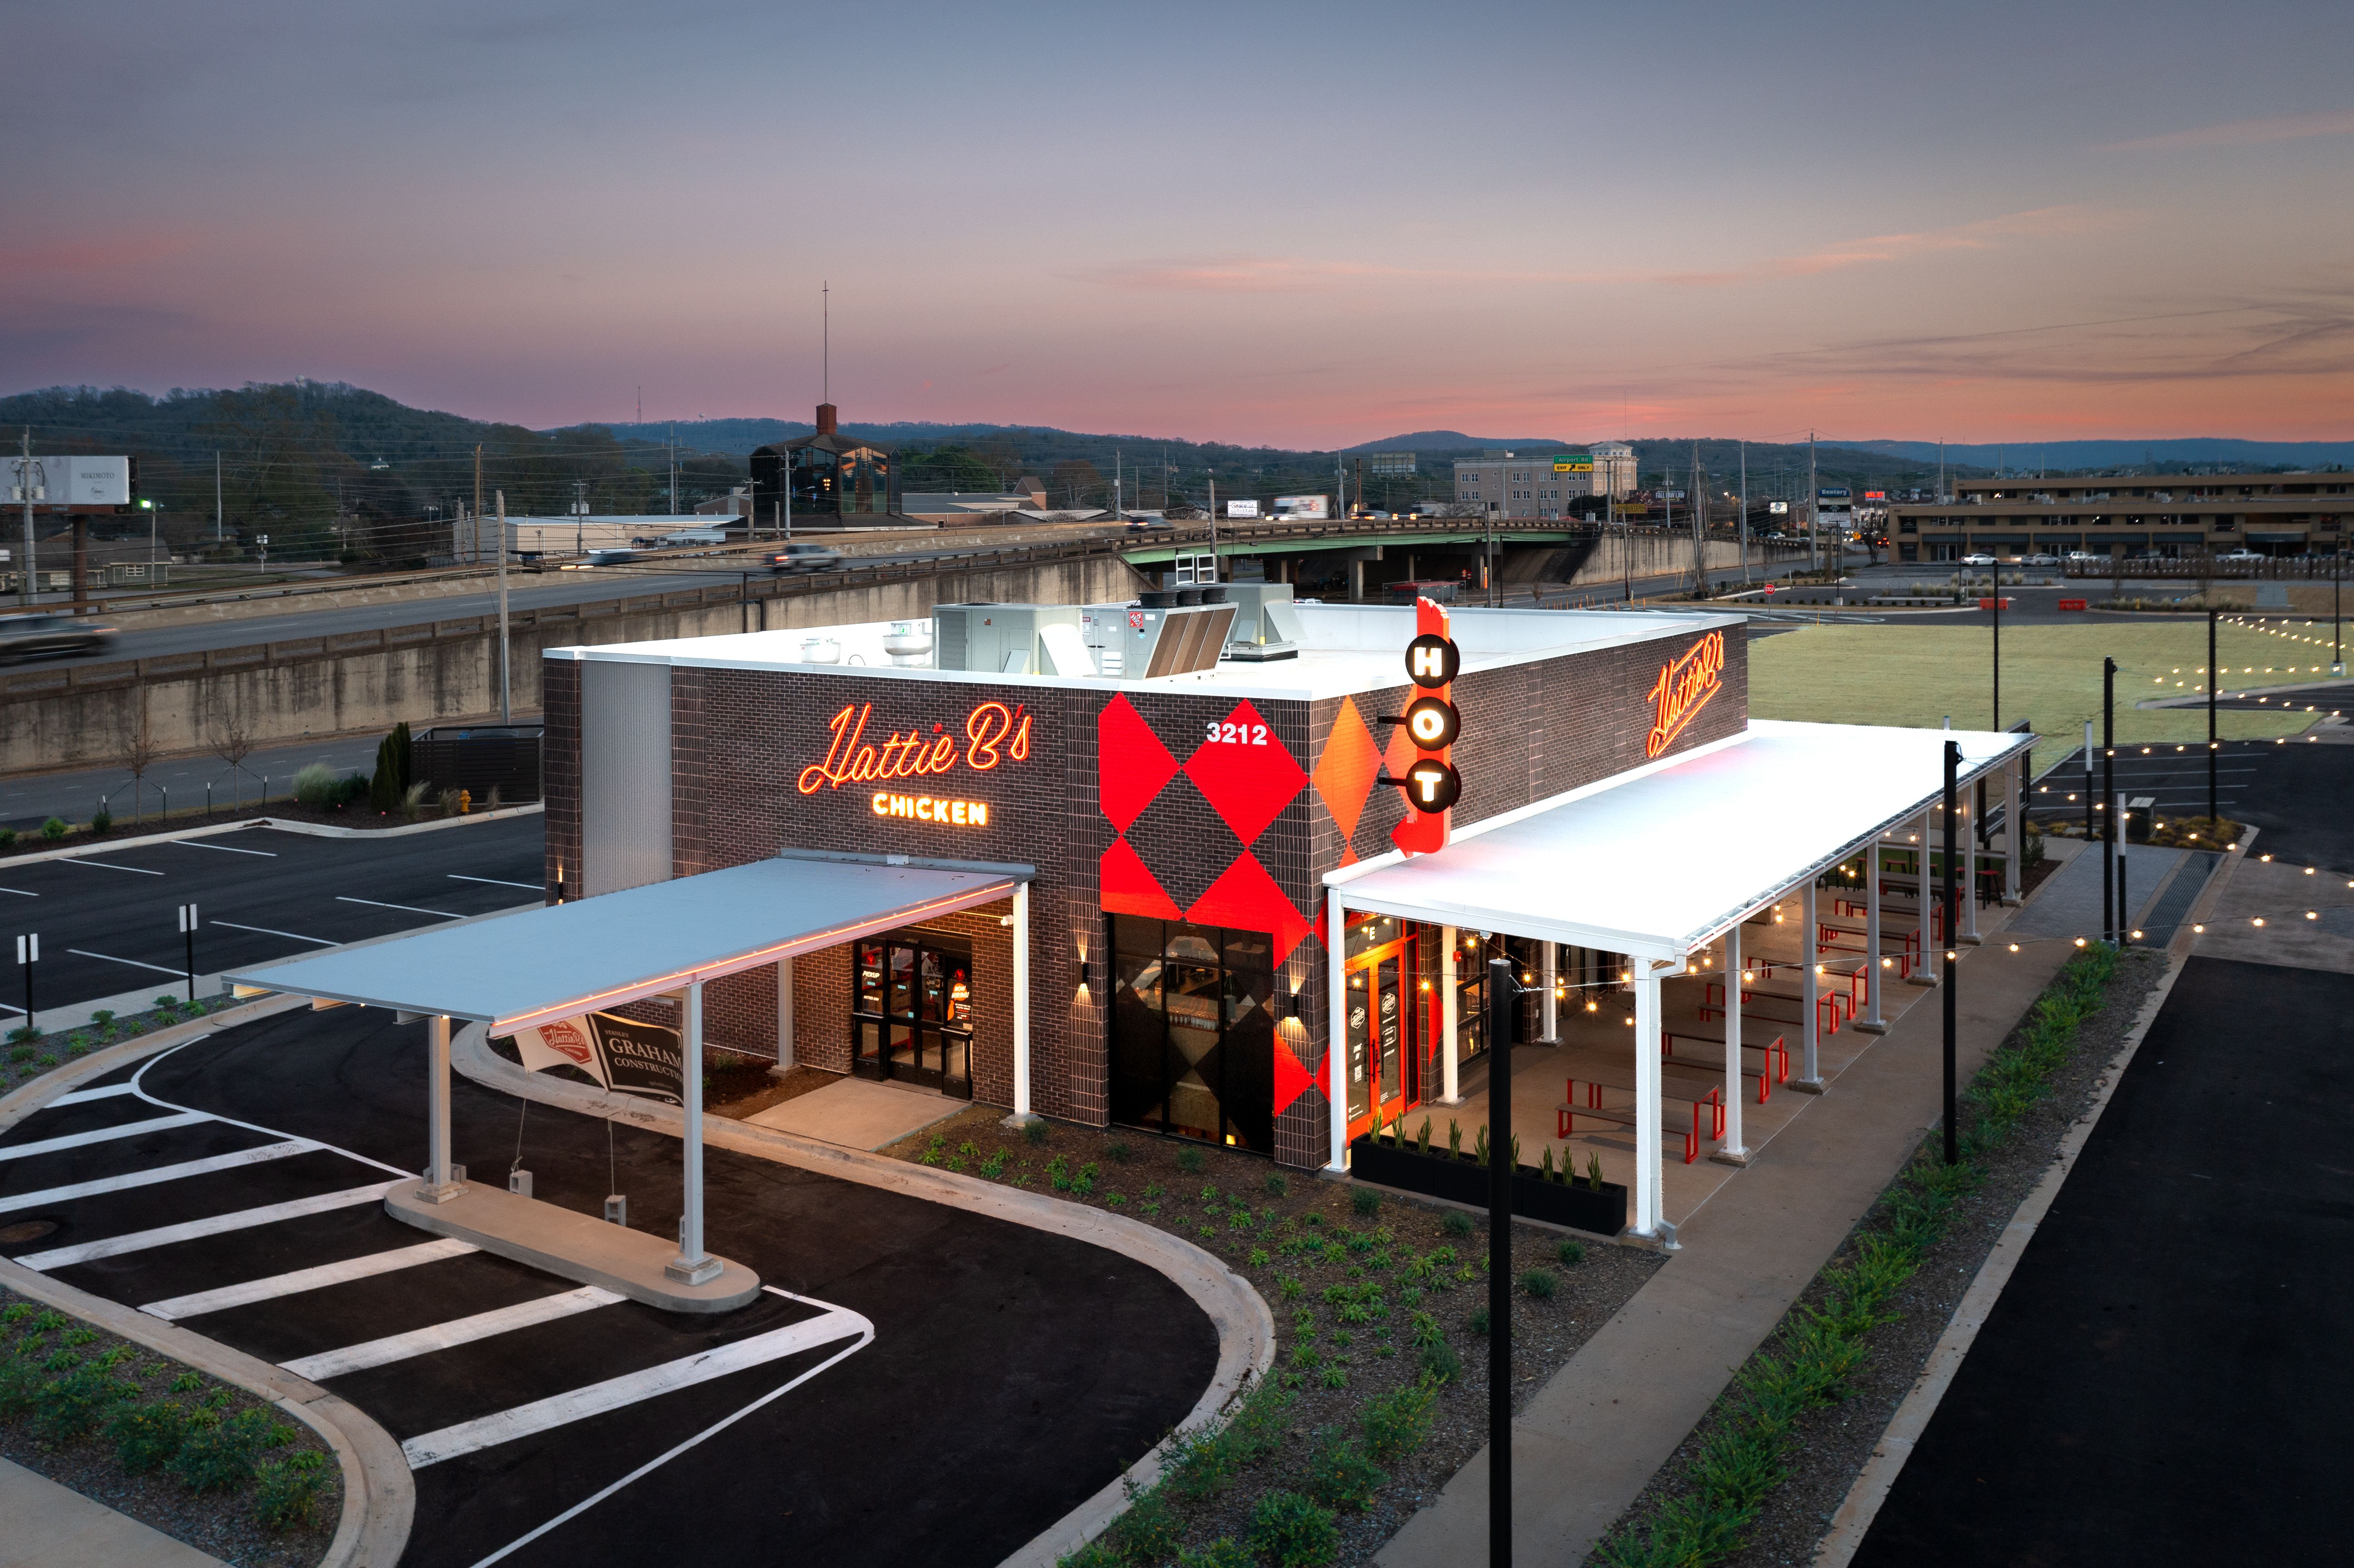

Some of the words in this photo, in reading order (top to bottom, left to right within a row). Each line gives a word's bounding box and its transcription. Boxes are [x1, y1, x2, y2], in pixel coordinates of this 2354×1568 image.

[1131, 614, 1141, 626] 3358
[1646, 656, 1705, 758] Hattie
[1206, 722, 1267, 745] 3212
[798, 701, 959, 795] Hattie
[966, 701, 1033, 770] B's
[872, 794, 987, 825] CHICKEN
[1369, 926, 1375, 941] E
[549, 1029, 576, 1045] Hattie
[572, 1032, 585, 1045] B's
[605, 1029, 629, 1038] STANLEY
[609, 1038, 682, 1072] GRAHAM
